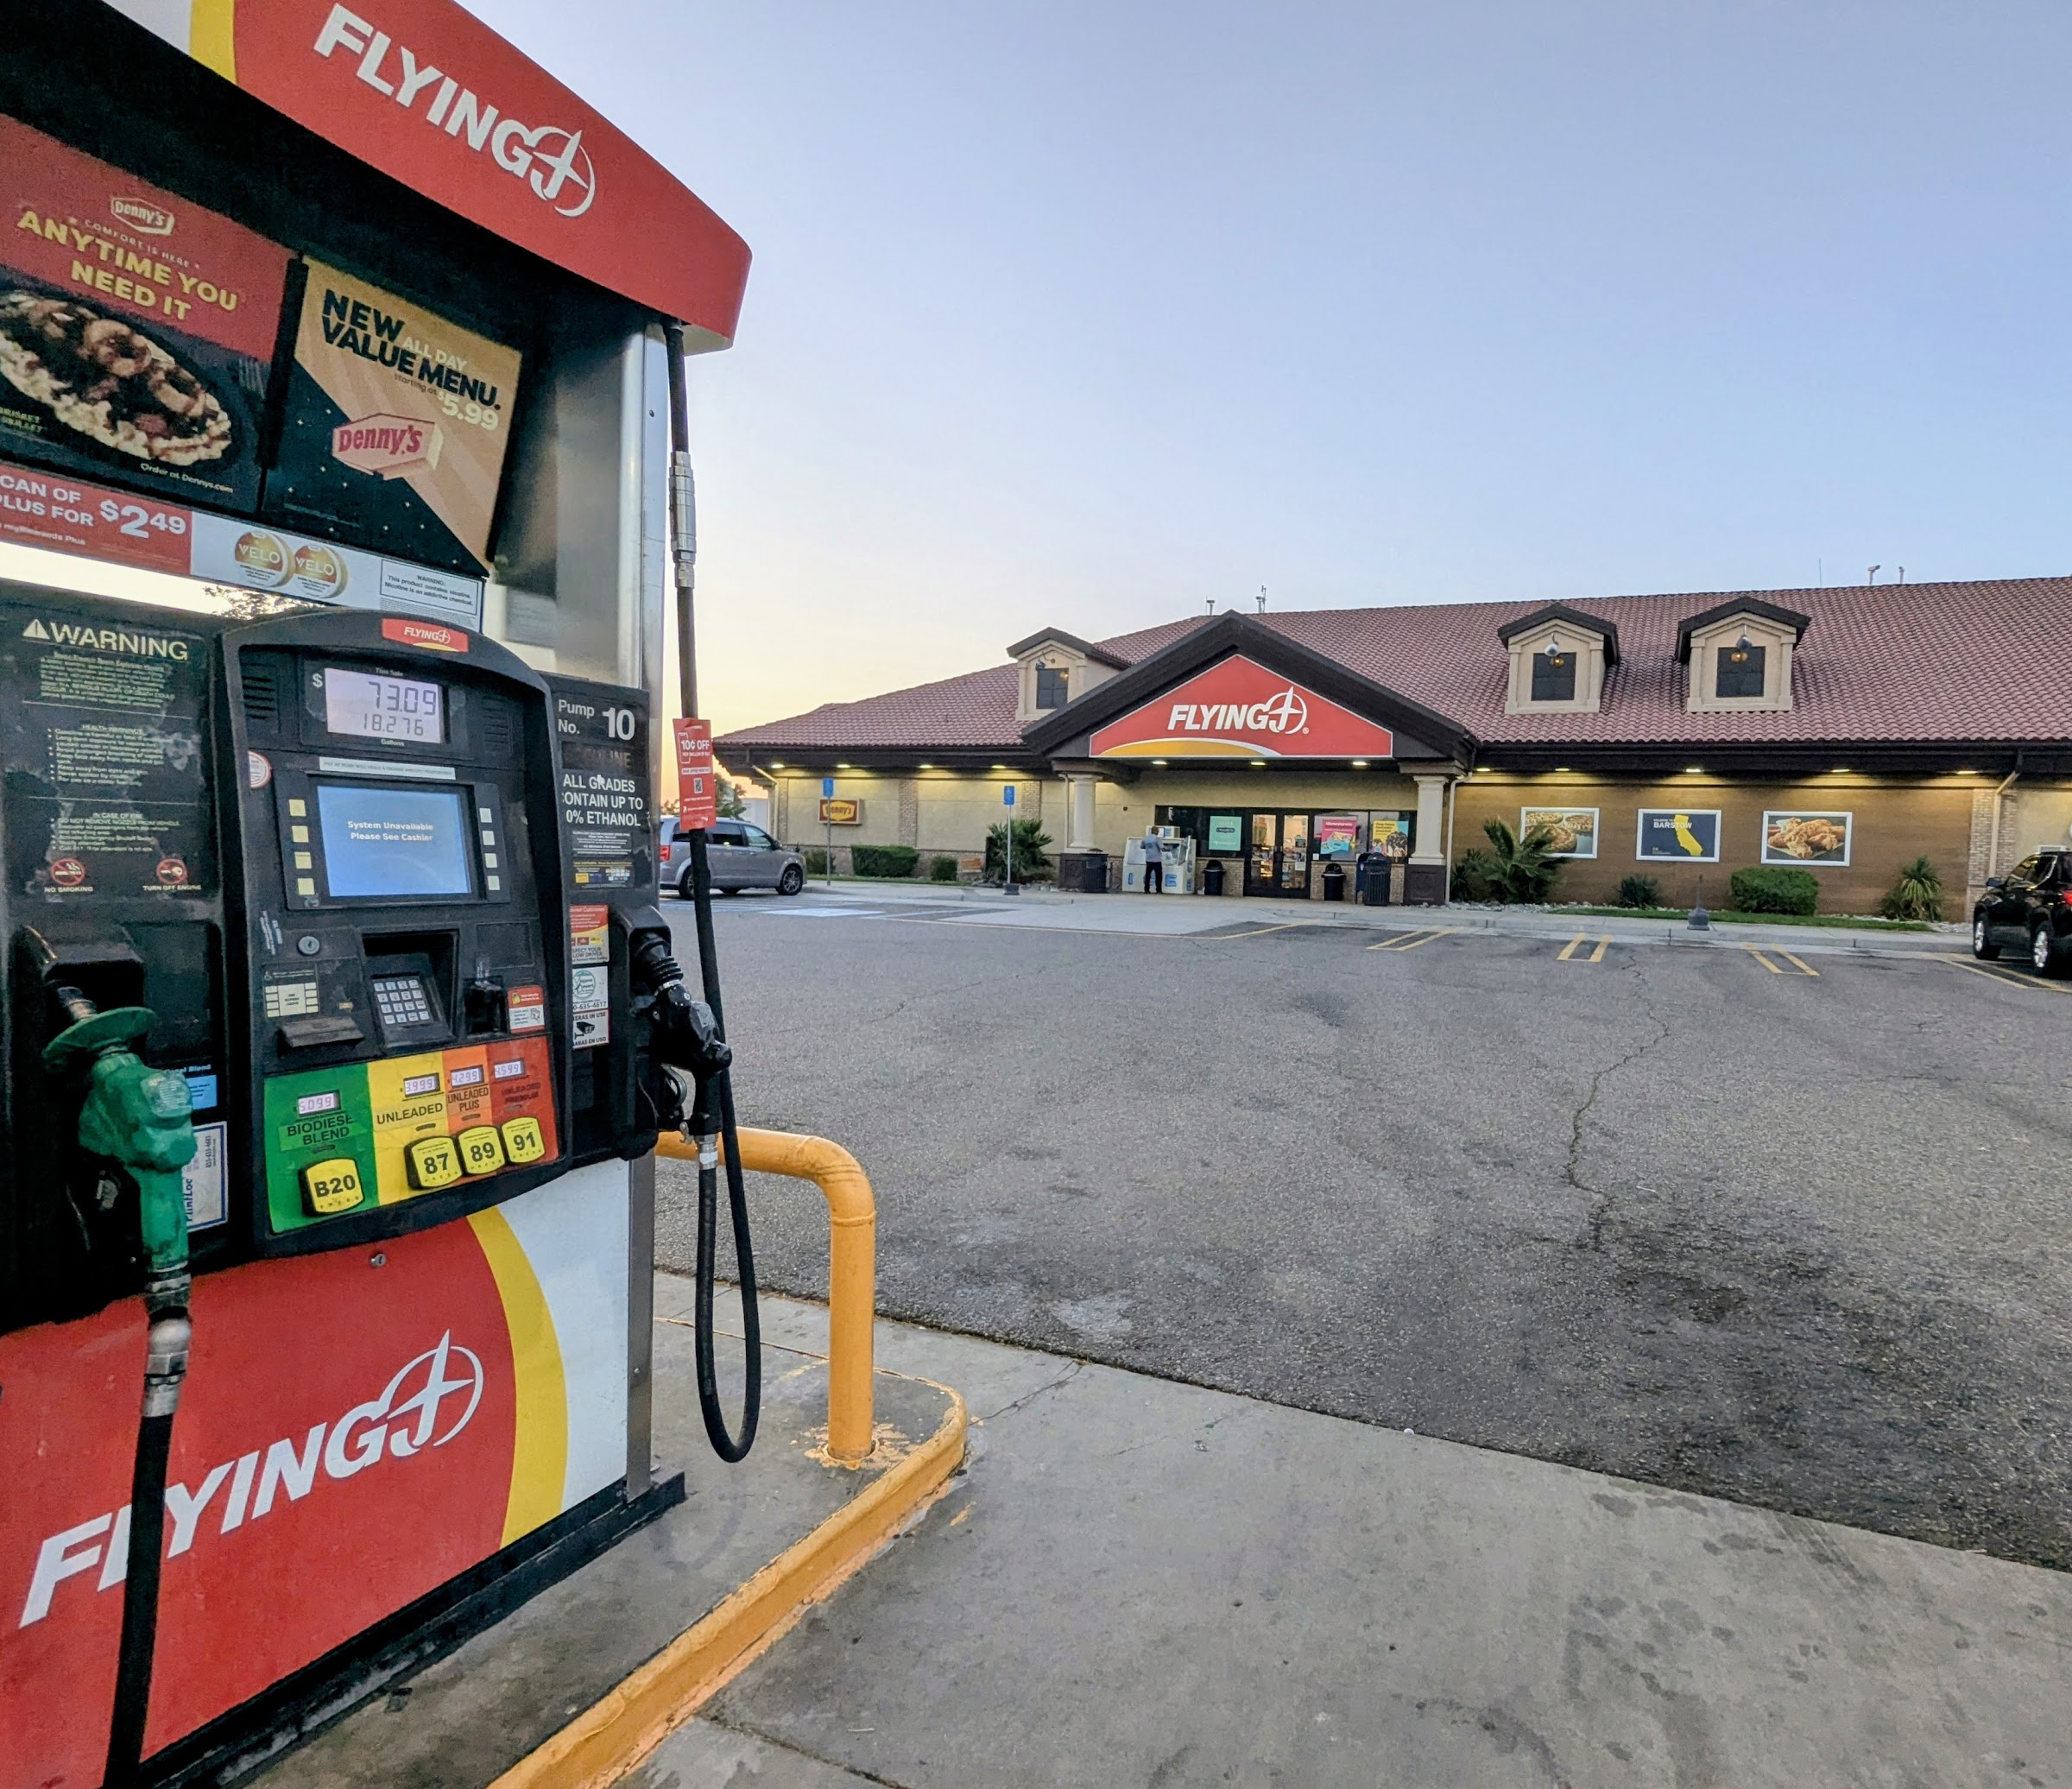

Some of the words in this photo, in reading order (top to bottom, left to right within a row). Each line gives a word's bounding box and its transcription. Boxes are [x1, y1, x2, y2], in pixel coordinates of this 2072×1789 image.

[115, 201, 166, 226] Denny's
[85, 219, 143, 249] COMFORT
[147, 244, 158, 255] IS
[161, 251, 190, 268] HERE
[17, 211, 172, 286] ANYTIME
[178, 272, 237, 311] YOU
[71, 260, 155, 307] NEED
[163, 296, 192, 320] IT
[322, 289, 406, 343] NEW
[322, 315, 416, 377] VALUE
[418, 357, 501, 411] MENU.
[402, 337, 432, 359] ALL
[435, 349, 467, 371] DAY
[438, 390, 499, 431] $5.99
[338, 424, 423, 455] Denny's
[141, 463, 168, 476] Order
[0, 475, 47, 498] CAN
[53, 487, 81, 504] OF
[52, 506, 95, 527] FOR
[238, 543, 281, 564] VELO
[295, 556, 334, 576] VELO
[384, 582, 408, 591] Nicotine
[401, 578, 423, 588] product
[425, 585, 447, 594] contains
[50, 622, 188, 661] WARNING
[312, 672, 324, 688] $
[368, 681, 437, 716] 73.09
[558, 699, 595, 719] Pump
[363, 713, 424, 736] 18.276
[558, 719, 580, 734] No.
[603, 707, 635, 741] 10
[381, 738, 405, 747] Gallons
[697, 740, 711, 750] OFF
[563, 774, 586, 788] ALL
[589, 774, 635, 793] GRADES
[562, 792, 608, 808] ONTAIN
[610, 795, 626, 809] UP
[629, 796, 643, 810] TO
[348, 821, 381, 830] System
[383, 822, 433, 831] Unavailable
[587, 811, 641, 826] ETHANOL
[351, 831, 381, 840] Please
[447, 1087, 489, 1103] UNLEADED
[459, 1099, 479, 1112] PLUS
[376, 1103, 443, 1125] UNLEADED
[302, 1127, 350, 1145] BLEND
[513, 1131, 536, 1151] 91
[471, 1141, 496, 1162] 89
[424, 1153, 449, 1174] 87
[314, 1174, 356, 1198] B20
